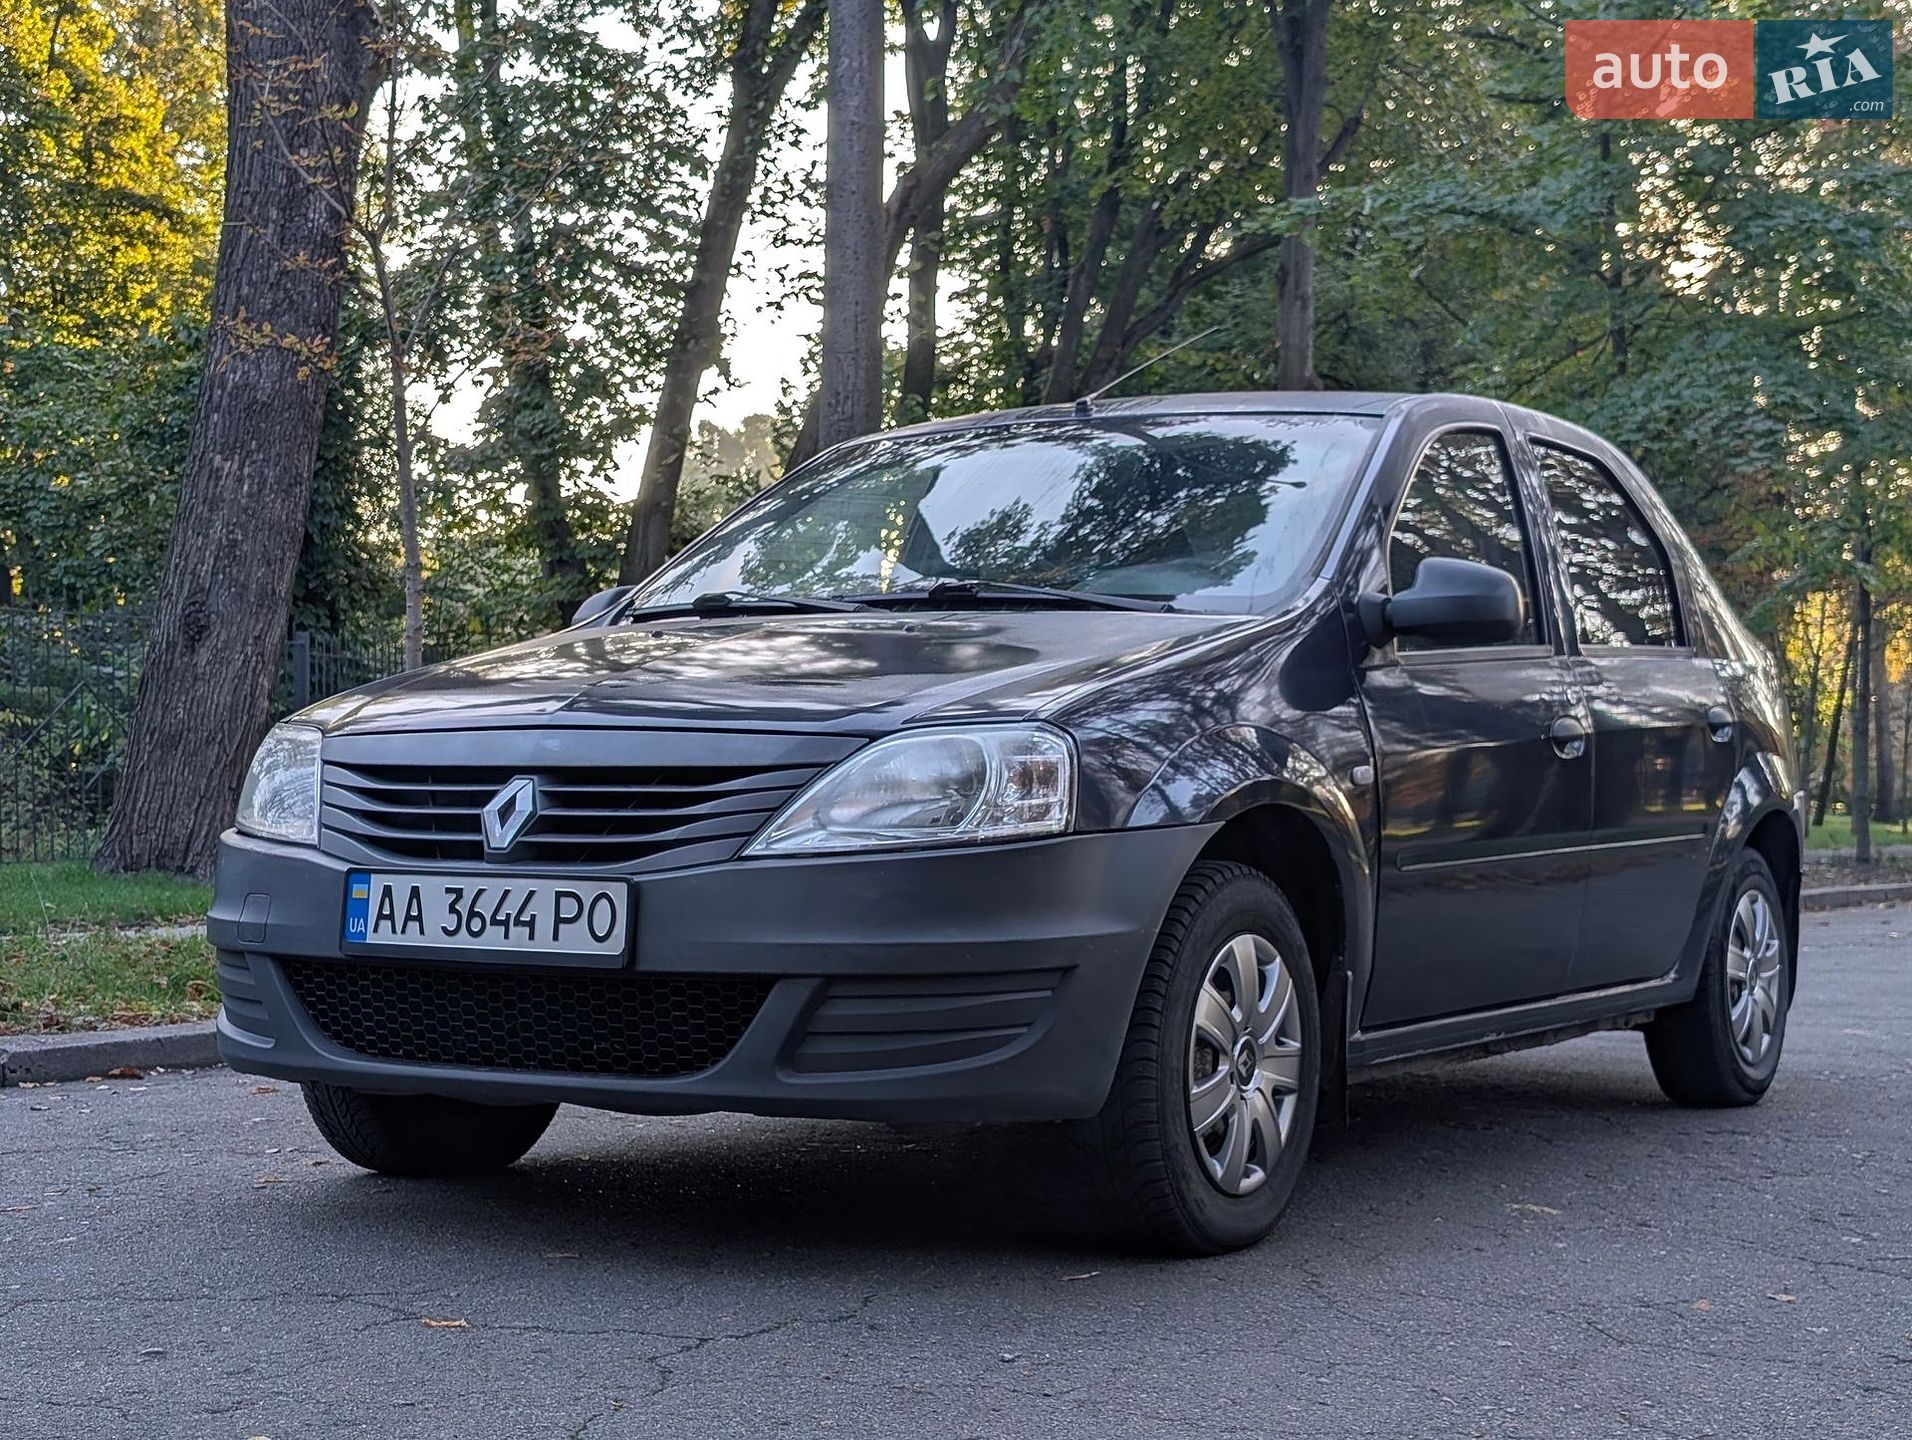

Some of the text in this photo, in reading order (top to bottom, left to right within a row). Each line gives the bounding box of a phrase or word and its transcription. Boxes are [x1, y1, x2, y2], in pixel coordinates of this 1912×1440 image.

[349, 917, 366, 934] UA
[372, 883, 617, 943] AA 3644 PO
